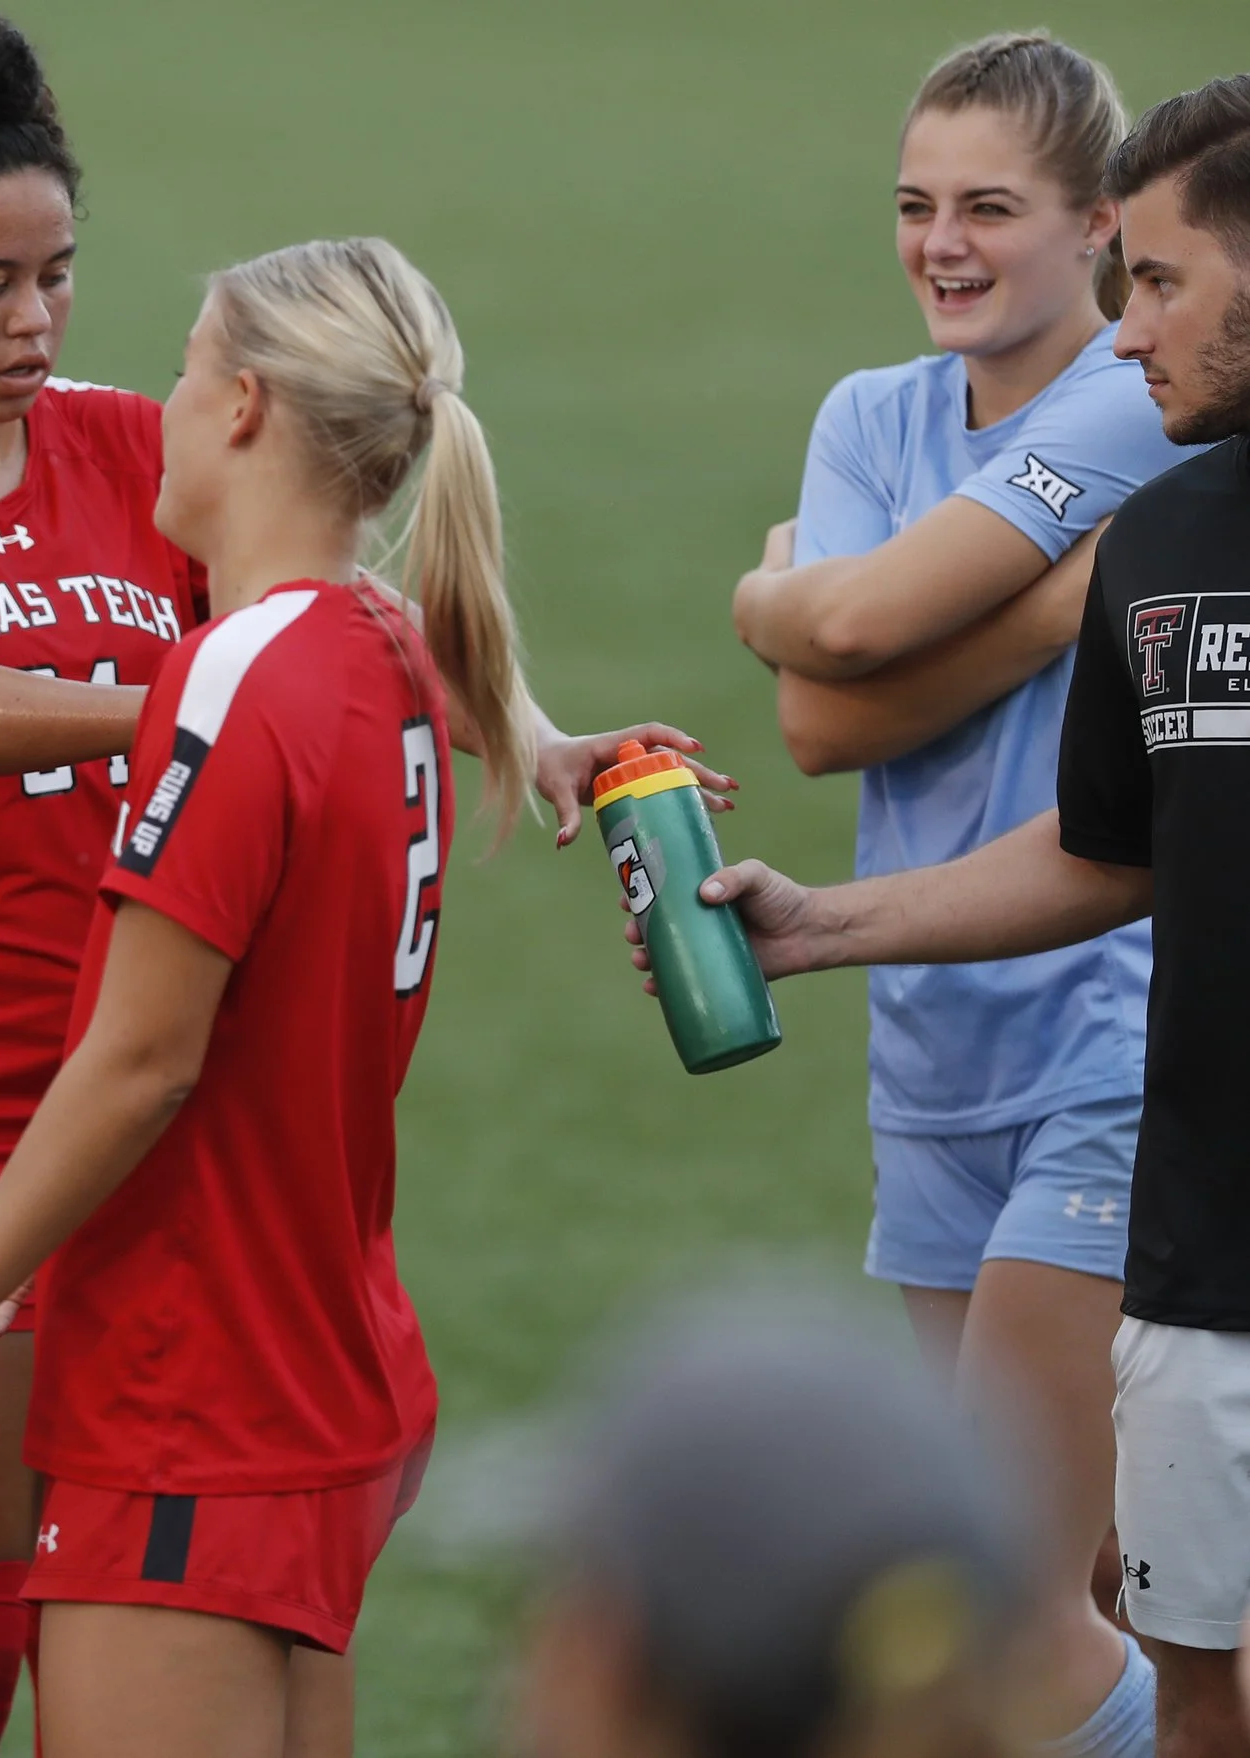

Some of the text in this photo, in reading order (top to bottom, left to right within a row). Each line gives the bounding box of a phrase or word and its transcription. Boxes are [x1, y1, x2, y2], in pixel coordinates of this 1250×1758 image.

[57, 574, 182, 644] TECH
[1196, 623, 1250, 671] RE
[1141, 710, 1188, 746] SOCCER
[131, 760, 192, 857] GUNS UP
[394, 713, 440, 1000] 2
